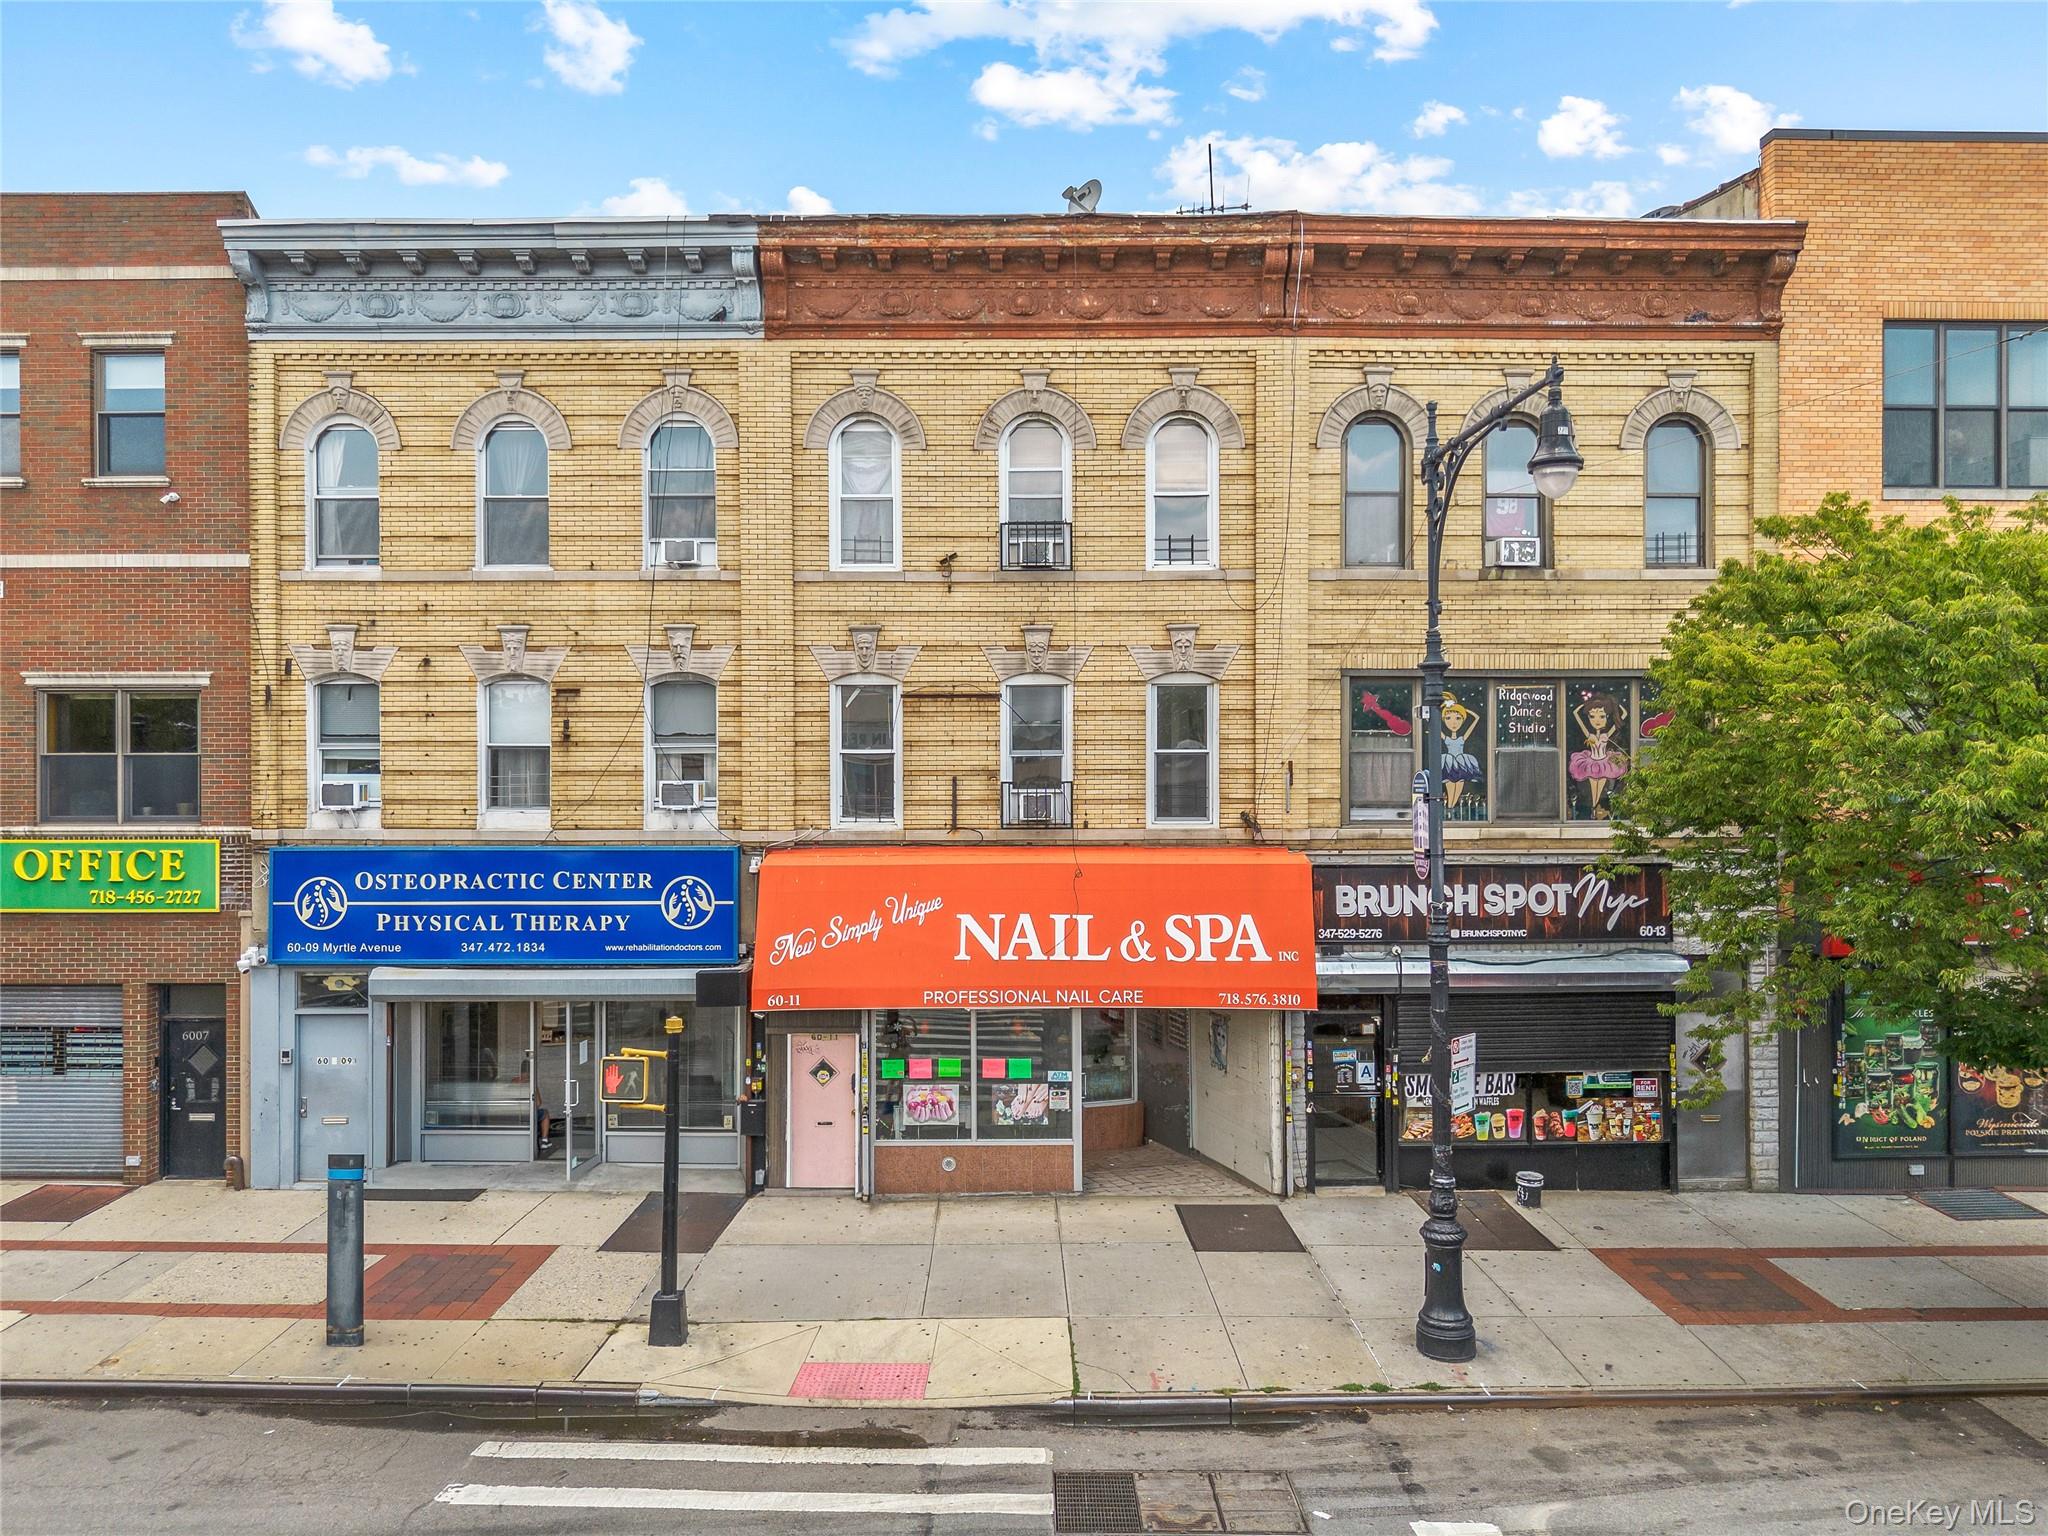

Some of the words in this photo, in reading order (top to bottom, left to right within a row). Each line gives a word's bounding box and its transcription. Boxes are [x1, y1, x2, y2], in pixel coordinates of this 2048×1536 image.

[1499, 688, 1553, 706] Ridgewood
[1510, 705, 1542, 717] Dance
[1508, 721, 1546, 733] Studio
[13, 849, 186, 882] OFFICE
[354, 870, 546, 891] OSTEOPRACTIC
[552, 870, 653, 891] CENTER
[89, 889, 202, 904] 718-456-2727
[1483, 883, 1572, 917] SPOT
[1572, 872, 1649, 932] Nyc
[376, 912, 504, 932] PHYSICAL
[511, 912, 631, 932] THERAPY
[769, 928, 817, 966] New
[821, 911, 884, 949] Simply
[885, 893, 944, 926] Unique
[1318, 928, 1383, 939] 347-529-5276
[1461, 929, 1528, 938] BRUNCHSPOTNYC
[1639, 925, 1667, 937] 60-13
[953, 913, 1112, 961] NAIL
[1119, 919, 1157, 963] &
[1164, 913, 1273, 962] SPA
[1278, 950, 1300, 962] INC
[286, 942, 319, 953] 60-09
[322, 942, 357, 955] Myrtle
[359, 942, 402, 953] Avenue
[460, 942, 546, 953] 347.472.1834
[604, 943, 722, 953] www.rehabilitationdoctors.com
[767, 994, 800, 1007] 60-11
[923, 989, 1052, 1005] PROFESSIONAL
[1056, 989, 1094, 1004] NAIL
[1099, 989, 1144, 1004] CARE
[1218, 992, 1301, 1006] 718.576.3810
[182, 1030, 209, 1041] 6007
[317, 1057, 329, 1065] 60
[341, 1057, 353, 1065] 09
[1360, 1065, 1372, 1078] A
[1485, 1073, 1515, 1094] BAR
[1479, 1097, 1500, 1106] WAFFLES
